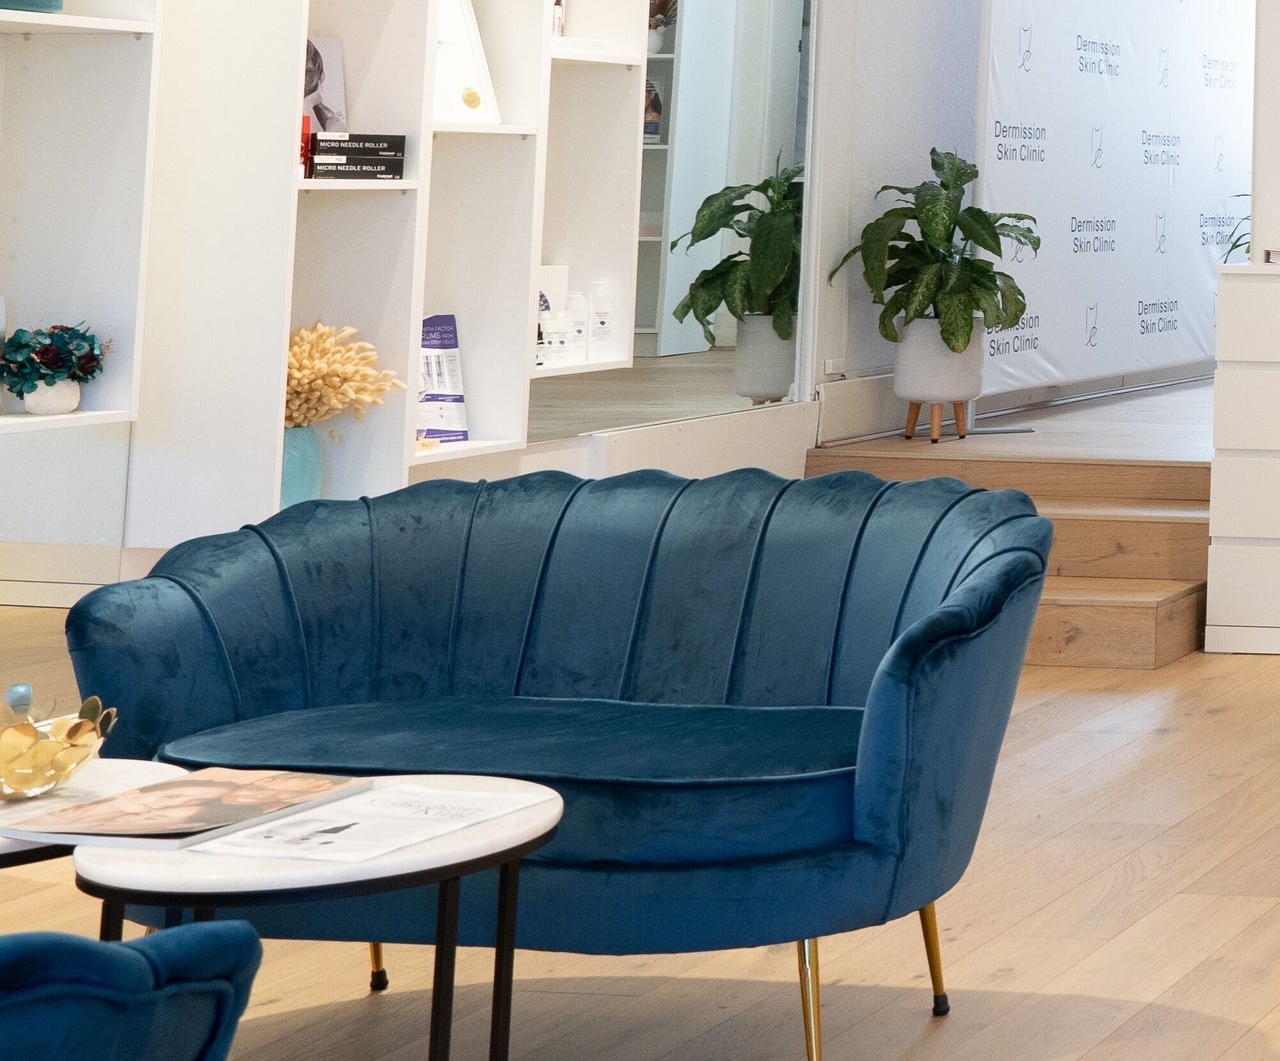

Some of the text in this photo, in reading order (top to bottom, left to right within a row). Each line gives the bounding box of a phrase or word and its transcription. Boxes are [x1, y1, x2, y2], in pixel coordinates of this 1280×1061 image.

[1076, 35, 1120, 56] Dermission
[1078, 56, 1120, 76] Skin Cinic
[994, 120, 1046, 140] Dermission
[1141, 130, 1181, 147] Dermission
[996, 143, 1045, 162] Skin Clinic
[1143, 149, 1180, 166] Skin Clinic
[1070, 216, 1116, 233] Dermission
[1199, 213, 1235, 228] Dermission
[1072, 236, 1116, 253] Skin Clinic
[1201, 231, 1234, 246] Skin Clinic
[1138, 299, 1178, 316] Dermission
[986, 313, 1040, 335] ession
[1140, 317, 1178, 335] Skin Clinic
[989, 334, 1039, 357] Skin Clinic
